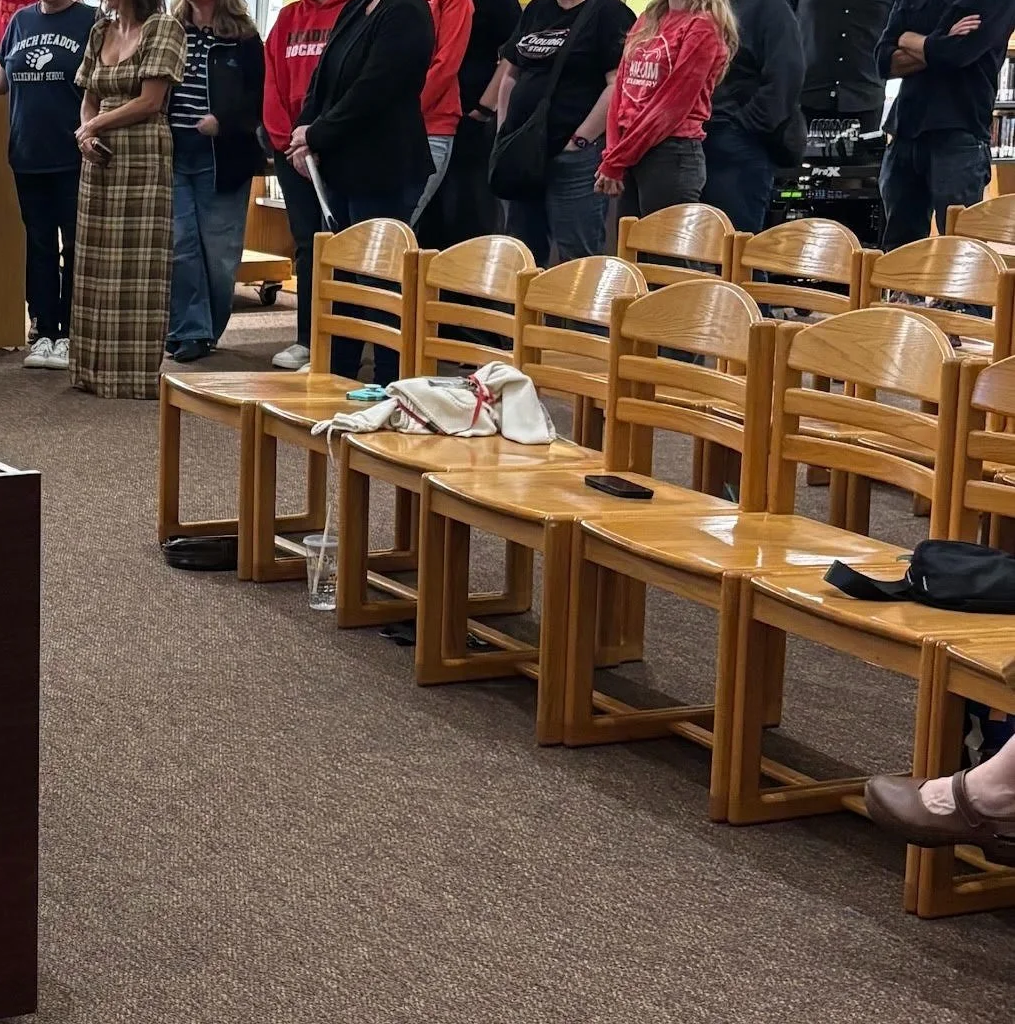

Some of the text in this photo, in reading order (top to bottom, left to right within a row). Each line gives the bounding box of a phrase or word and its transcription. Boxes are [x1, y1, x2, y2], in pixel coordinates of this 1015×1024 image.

[39, 33, 81, 54] MEADOW
[285, 42, 327, 58] HOCKE
[45, 71, 65, 81] SCHOOL
[811, 166, 842, 177] ProX
